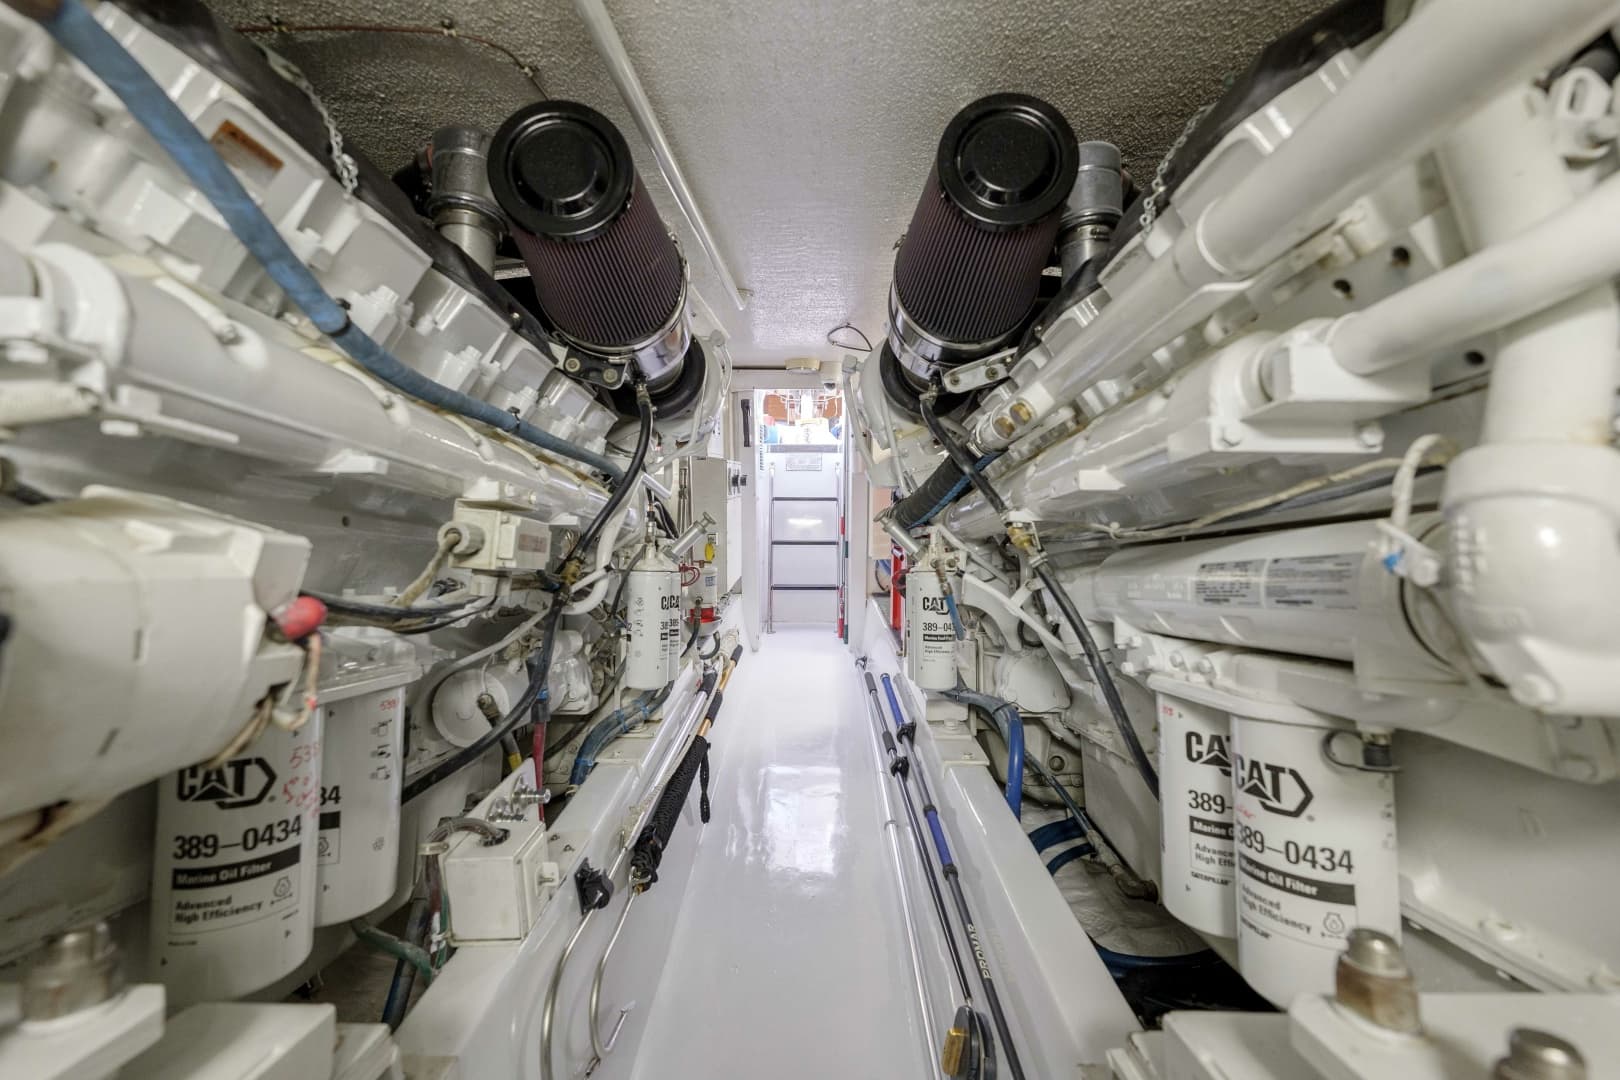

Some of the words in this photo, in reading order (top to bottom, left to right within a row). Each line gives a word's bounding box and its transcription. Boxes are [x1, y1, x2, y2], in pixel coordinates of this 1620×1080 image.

[1185, 731, 1232, 767] CA
[177, 758, 253, 801] CAT
[1234, 753, 1286, 803] CAT
[218, 868, 238, 881] Oil
[240, 861, 273, 877] Filter
[1267, 871, 1284, 886] Oil
[1285, 877, 1318, 895] Filter
[202, 901, 264, 921] Efficiency
